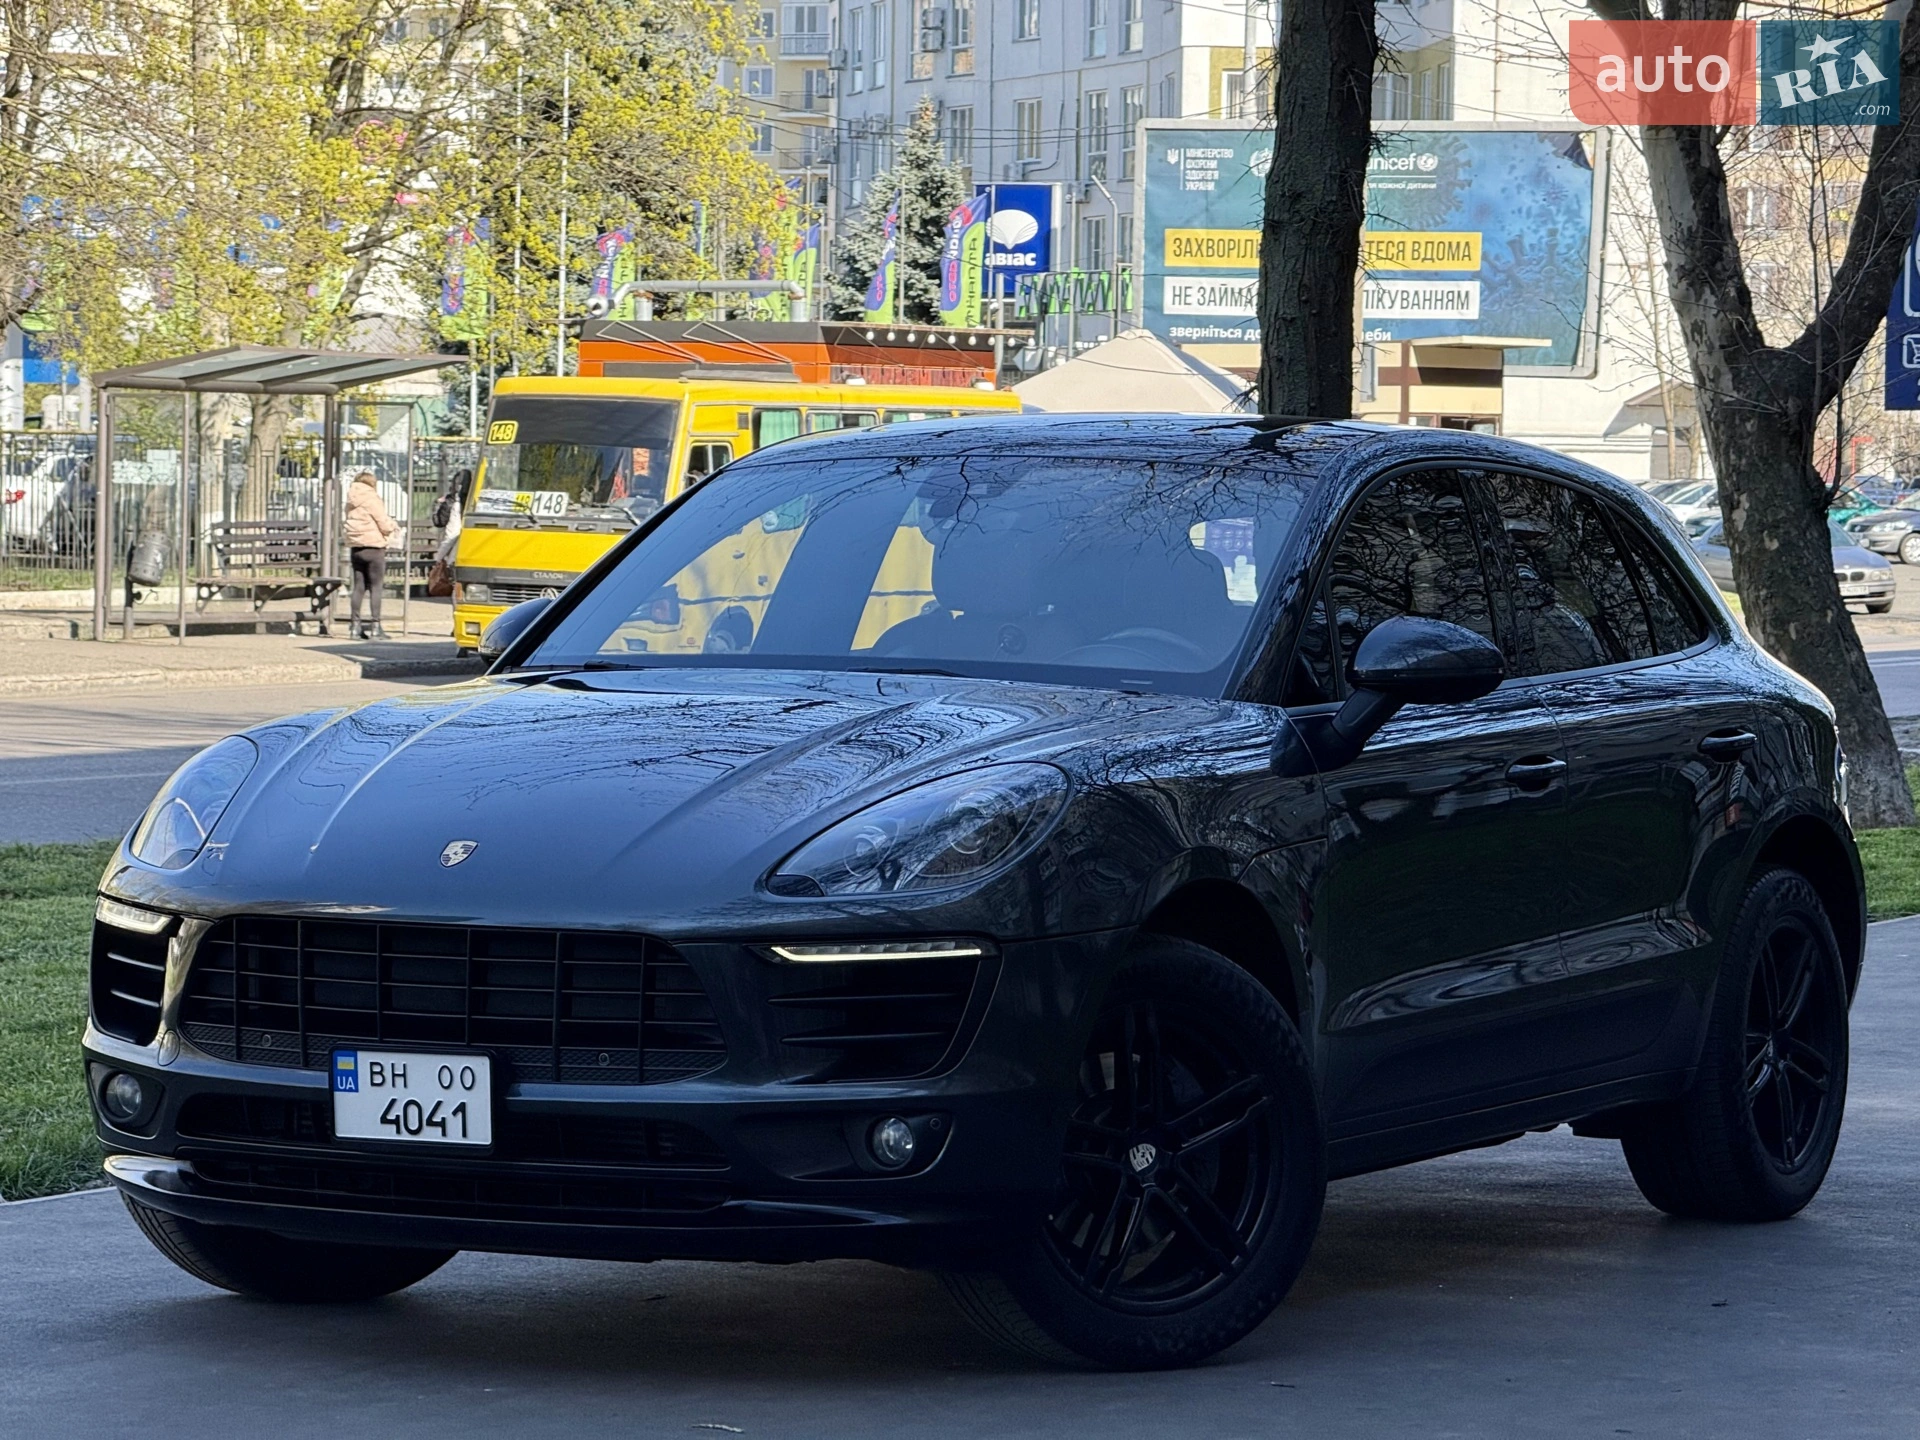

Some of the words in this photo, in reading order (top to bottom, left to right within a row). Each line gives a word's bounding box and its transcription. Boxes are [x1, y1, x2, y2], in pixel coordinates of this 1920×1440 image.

[1365, 240, 1406, 261] ТЕСЯ
[1411, 241, 1472, 263] ВДОМА
[1172, 286, 1193, 306] НЕ
[1197, 283, 1258, 308] ЗАЙМА
[1169, 325, 1242, 339] зверніться
[491, 424, 515, 441] 148
[535, 493, 564, 514] 148
[337, 1076, 356, 1091] UA
[380, 1098, 468, 1138] 4041
